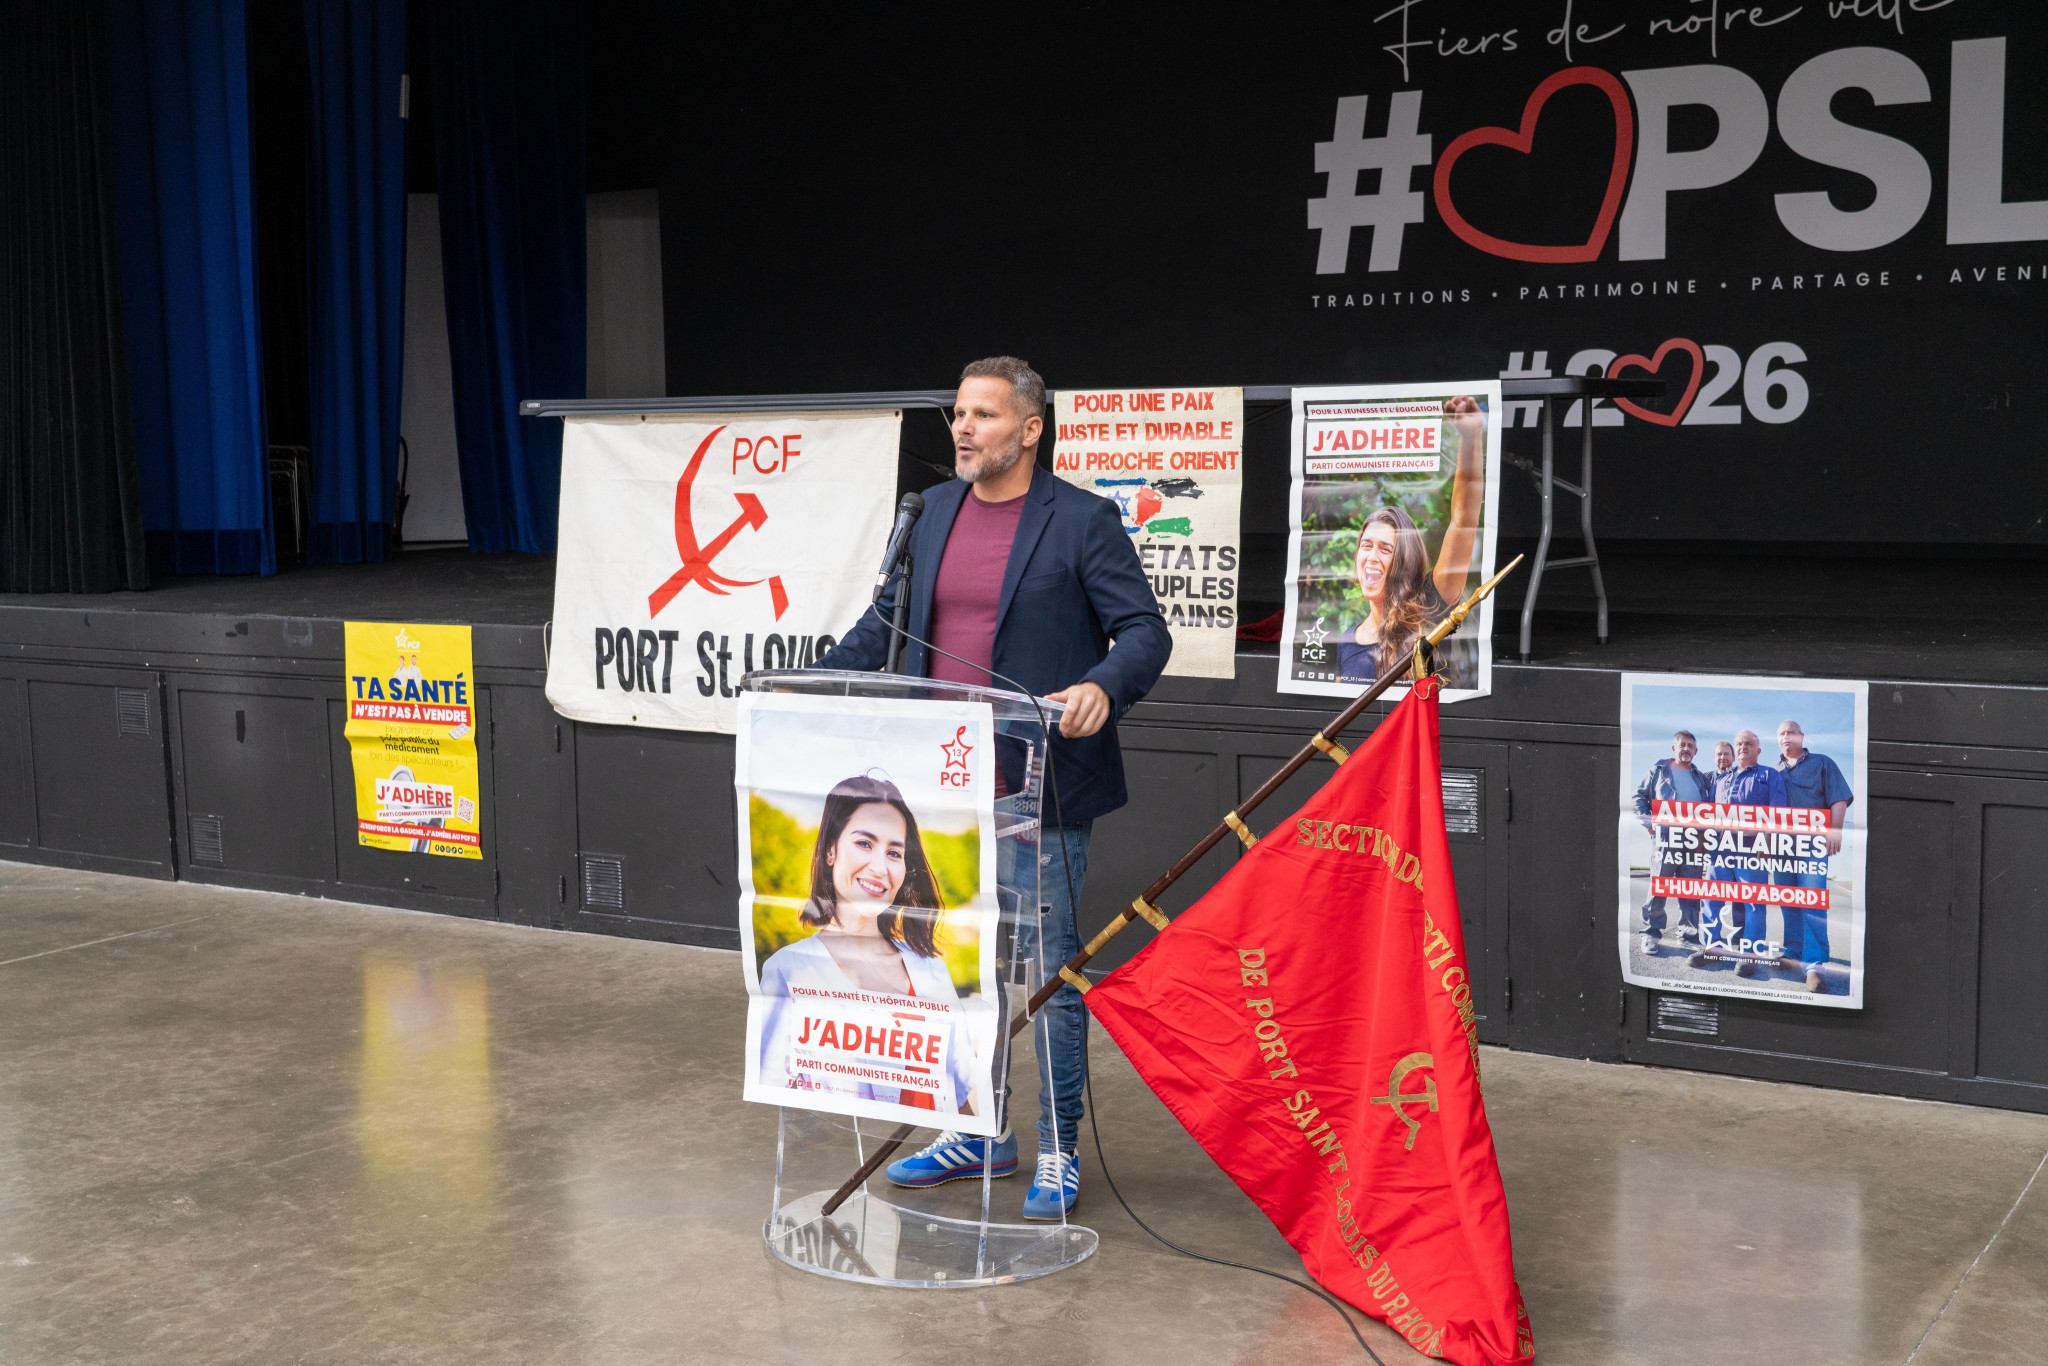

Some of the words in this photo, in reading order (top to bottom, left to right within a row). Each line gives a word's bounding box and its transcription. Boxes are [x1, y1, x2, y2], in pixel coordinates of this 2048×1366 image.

[1374, 0, 1518, 83] Fiers
[1547, 0, 1626, 62] de
[1312, 289, 1471, 308] TRADITIONS
[1519, 280, 1697, 300] PATRIMOINE
[1751, 271, 1890, 291] PARTAGE
[1074, 394, 1124, 413] POUR
[1129, 392, 1165, 412] UNE
[1171, 391, 1215, 411] PAIX
[1344, 407, 1379, 415] JEUNESSE
[1379, 406, 1387, 414] ET
[1058, 423, 1110, 442] JUSTE
[1116, 423, 1139, 442] ET
[1144, 421, 1233, 441] DURABLE
[1312, 421, 1436, 452] J'ADHÈRE
[733, 434, 802, 475] PCF
[1055, 452, 1080, 471] AU
[1086, 451, 1164, 471] PROCHE
[1169, 451, 1239, 471] ORIENT
[1311, 462, 1333, 470] PARTI
[1335, 461, 1390, 469] COMMUNISTE
[1392, 459, 1434, 470] FRANÇAIS
[1139, 537, 1237, 572] ÉTATS
[407, 641, 421, 649] PCF
[1301, 648, 1327, 660] PCF
[595, 626, 680, 694] PORT
[352, 676, 385, 700] TA
[388, 672, 468, 705] SANTÉ
[355, 704, 388, 718] N'EST
[388, 706, 411, 719] PAS
[412, 704, 422, 720] À
[422, 708, 468, 723] VENDRE
[385, 741, 440, 755] médicament
[428, 737, 440, 746] du
[952, 748, 962, 757] 13
[384, 752, 400, 762] des
[940, 771, 971, 787] PCF
[377, 785, 453, 808] J'ADHÈRE
[394, 810, 428, 818] COMMUNISTE
[428, 810, 452, 818] FRANÇAIS
[1655, 800, 1828, 833] AUGMENTER
[391, 826, 399, 834] LA
[461, 834, 471, 842] PCF
[1297, 817, 1401, 873] SECTION
[1655, 825, 1700, 850] LES
[1702, 828, 1828, 859] SALAIRES
[1654, 851, 1684, 865] PAS
[1685, 851, 1712, 866] LES
[1714, 854, 1828, 876] ACTIONNAIRES
[1655, 878, 1739, 900] L'HUMAIN
[1739, 938, 1781, 957] PCF
[1238, 947, 1269, 987] DE
[1719, 955, 1753, 964] COMMUNISTE
[792, 987, 818, 997] POUR
[819, 990, 831, 998] LA
[832, 991, 860, 1001] SANTÉ
[861, 994, 870, 1003] ET
[918, 1001, 950, 1013] PUBLIC
[797, 1016, 942, 1065] J'ADHÈRE
[1245, 996, 1299, 1080] PORT
[796, 1058, 823, 1071] PARTI
[824, 1062, 890, 1081] COMMUNISTE
[891, 1072, 940, 1089] FRANÇAIS
[1281, 1089, 1349, 1174] SAINT
[1335, 1178, 1380, 1269] LOUIS
